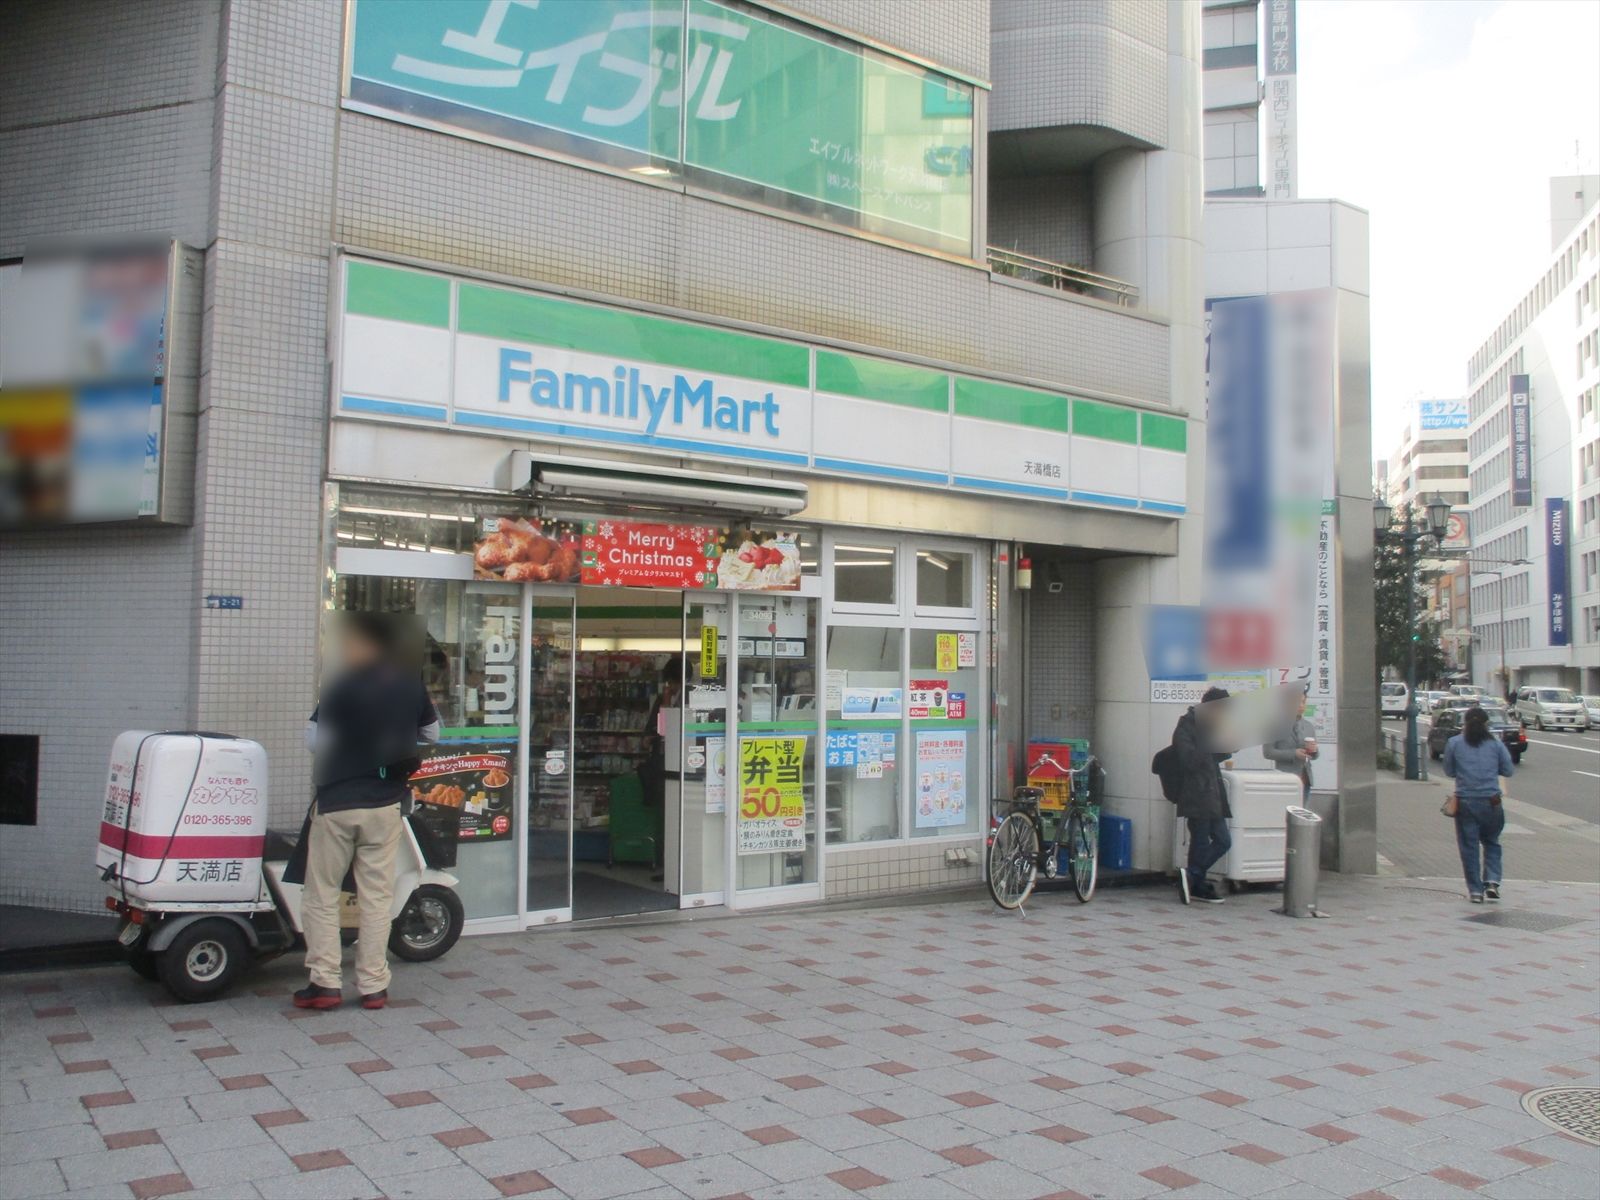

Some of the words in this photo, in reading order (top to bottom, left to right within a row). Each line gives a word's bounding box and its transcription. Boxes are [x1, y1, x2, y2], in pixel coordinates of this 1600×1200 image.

[498, 347, 780, 438] FamilyMart
[1023, 460, 1062, 479] 天満橋店
[1551, 509, 1562, 546] MIZUHO
[628, 530, 675, 551] Merry
[609, 548, 694, 567] Christmas
[742, 740, 795, 755] プレート型
[826, 734, 858, 749] たばこ
[742, 755, 801, 785] 弁当
[192, 785, 259, 805] カクヤス
[741, 787, 781, 819] 50
[183, 814, 253, 826] 0120-365-396
[176, 860, 244, 882] 天満店
